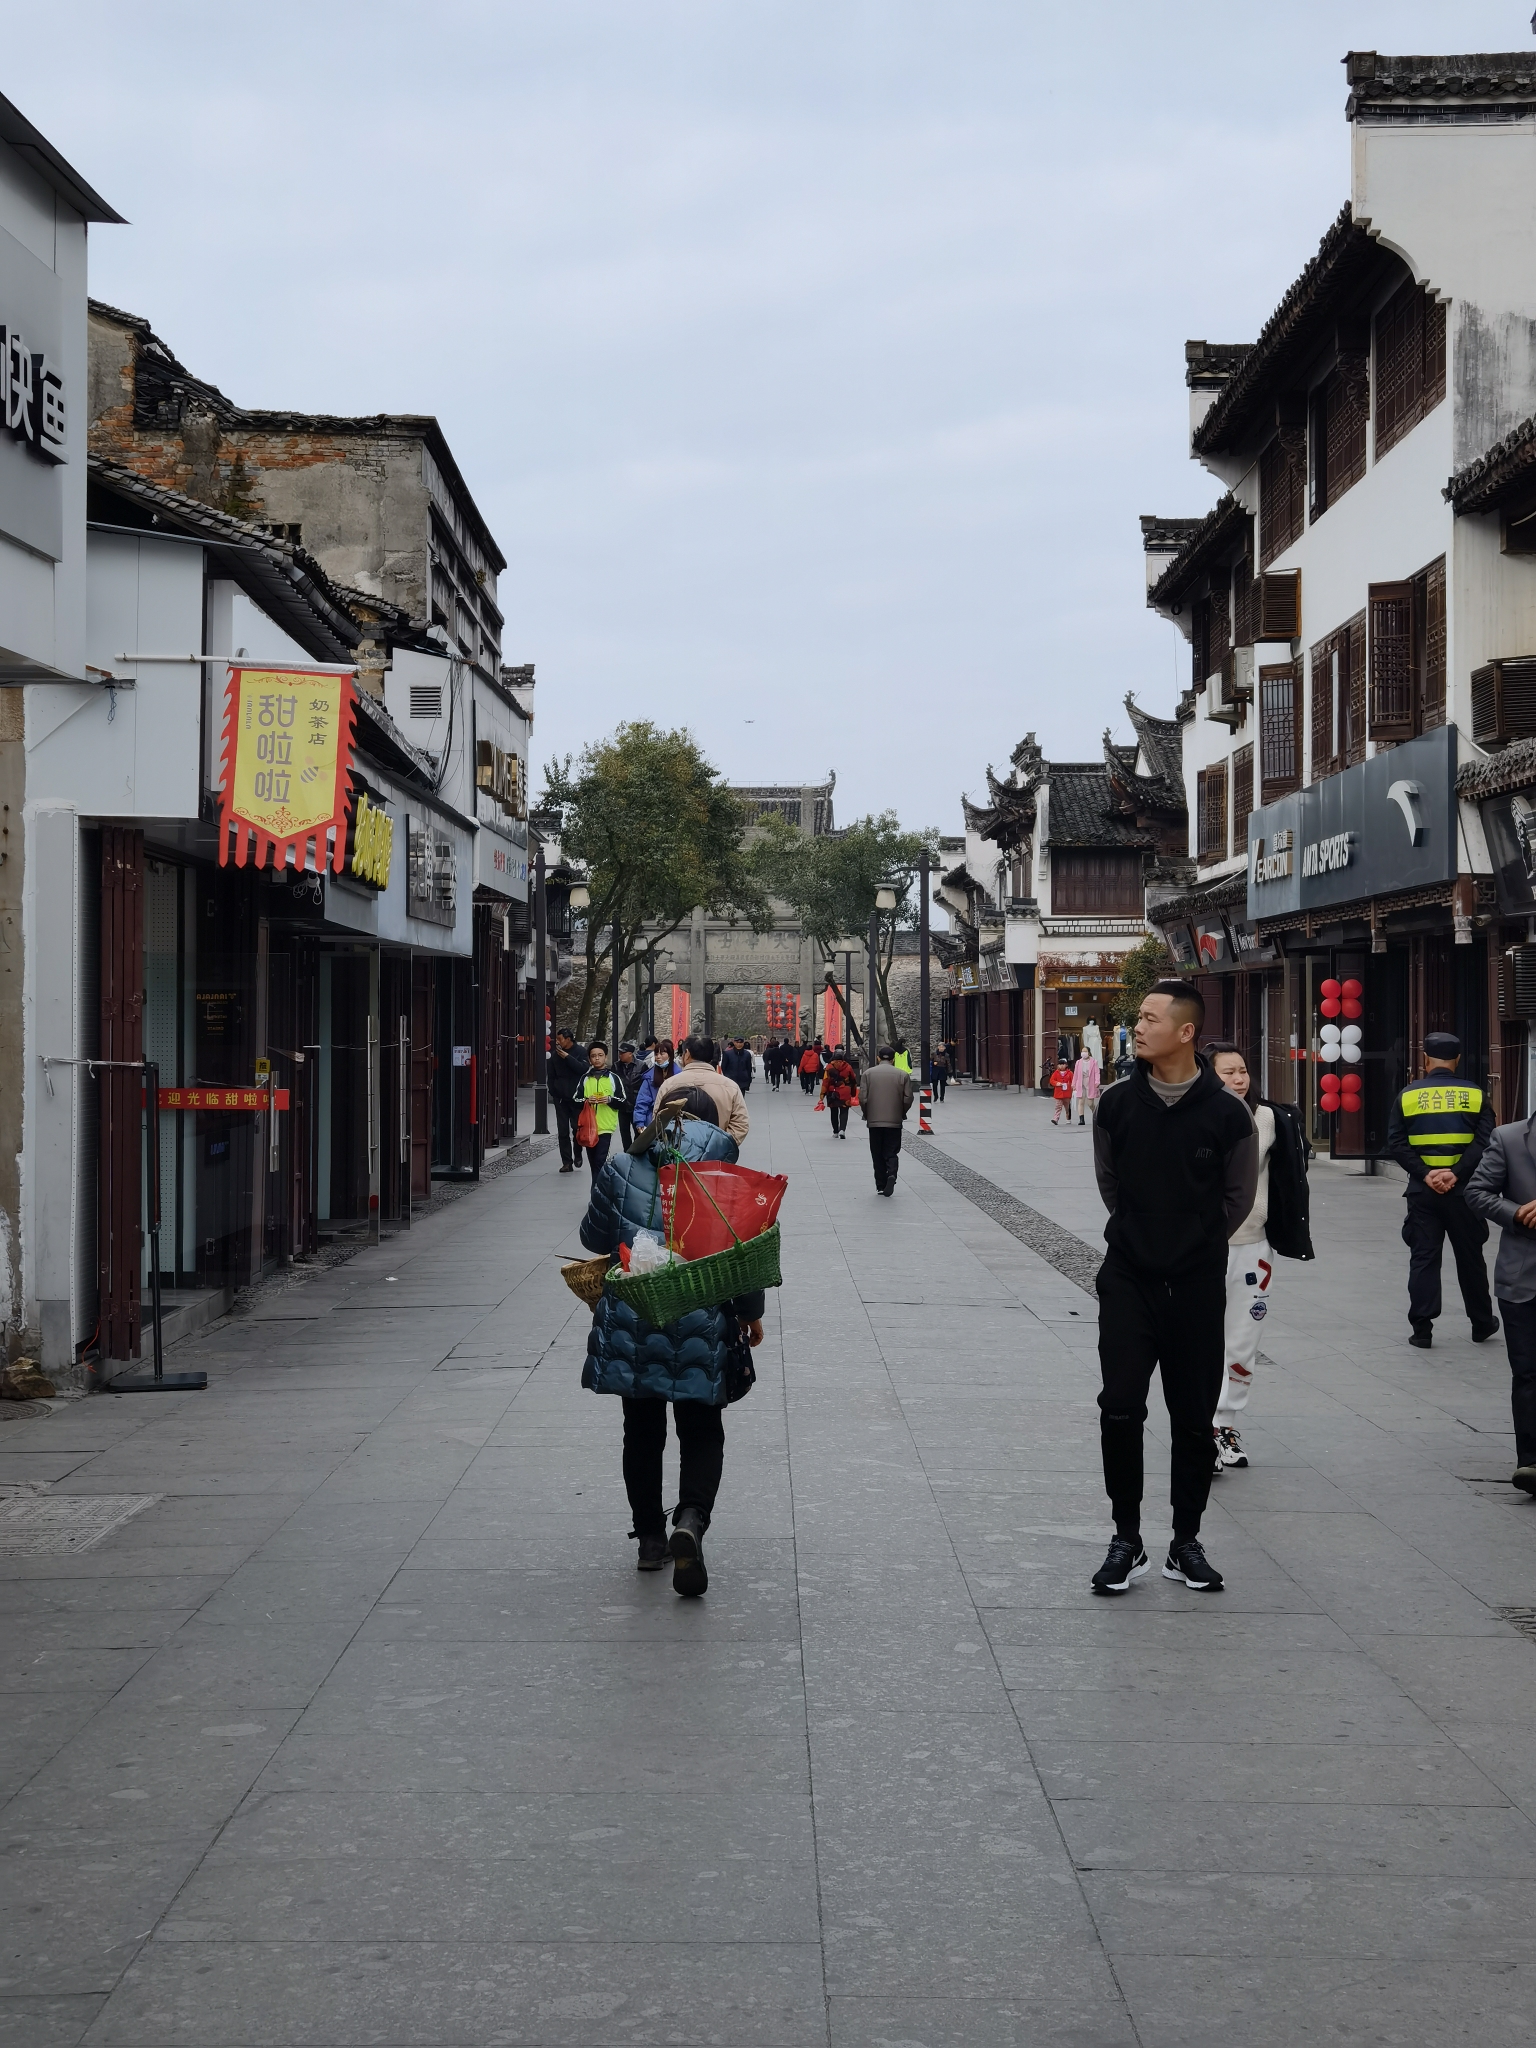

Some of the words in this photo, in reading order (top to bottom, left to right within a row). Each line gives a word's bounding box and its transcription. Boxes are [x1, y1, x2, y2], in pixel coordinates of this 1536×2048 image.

[1, 325, 69, 465] 快鱼
[308, 698, 330, 746] 奶茶店
[254, 693, 298, 803] 甜啦啦
[1251, 839, 1288, 884] YEARCON
[1302, 844, 1318, 878] ANTA
[1319, 832, 1350, 874] SPORTS
[159, 1092, 270, 1106] 迎光临甜啦
[1418, 1089, 1470, 1110] 综合管理
